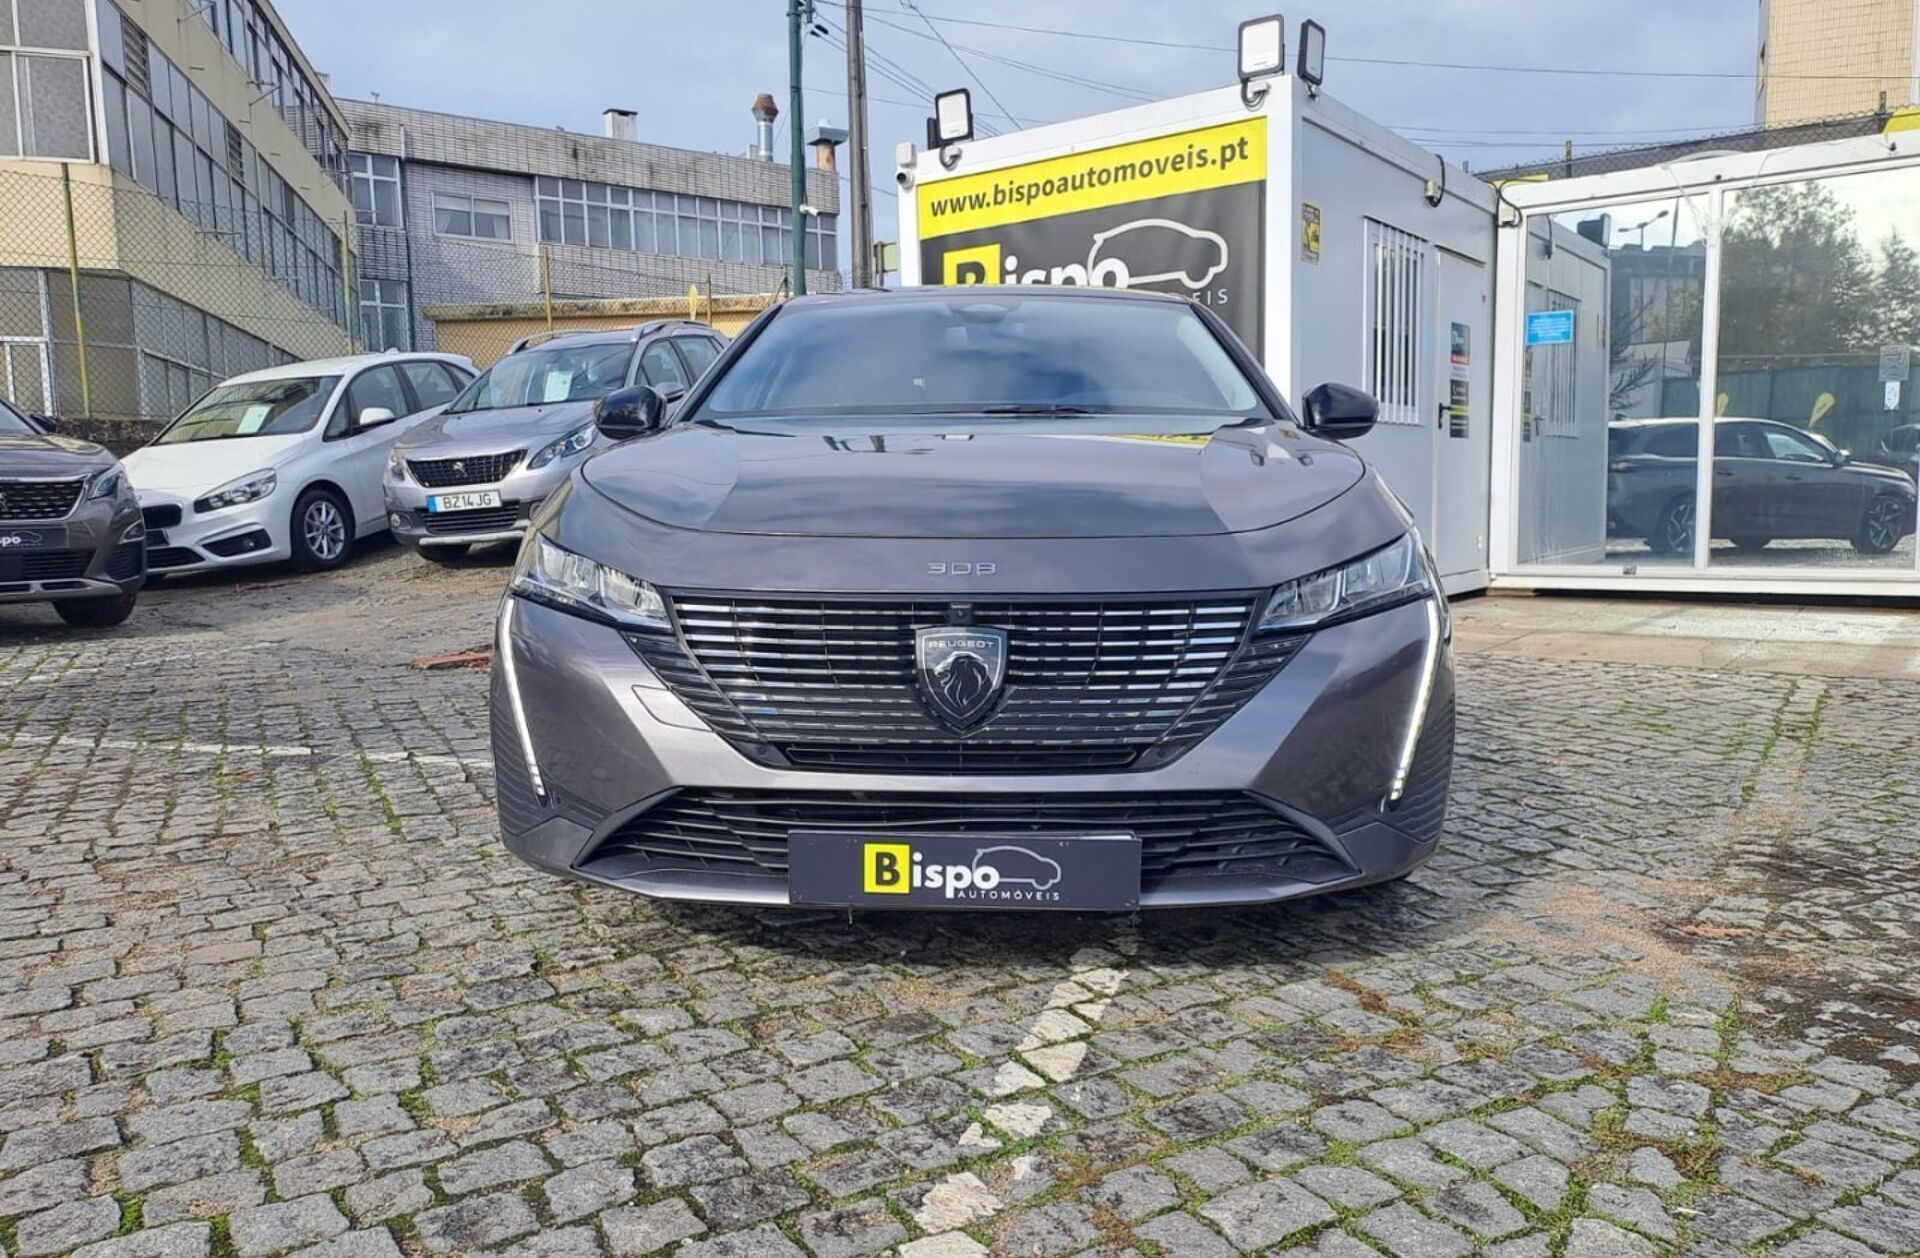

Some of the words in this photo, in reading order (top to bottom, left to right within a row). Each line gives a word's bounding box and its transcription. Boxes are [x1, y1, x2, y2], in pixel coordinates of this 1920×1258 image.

[930, 136, 1249, 217] www.bispoautomoveis.pt
[957, 255, 1130, 288] Bio
[927, 562, 996, 575] 308
[928, 640, 994, 649] PEUGEOT
[875, 852, 1000, 898] Bispo
[958, 889, 1060, 901] AUTOMÓVEIS
